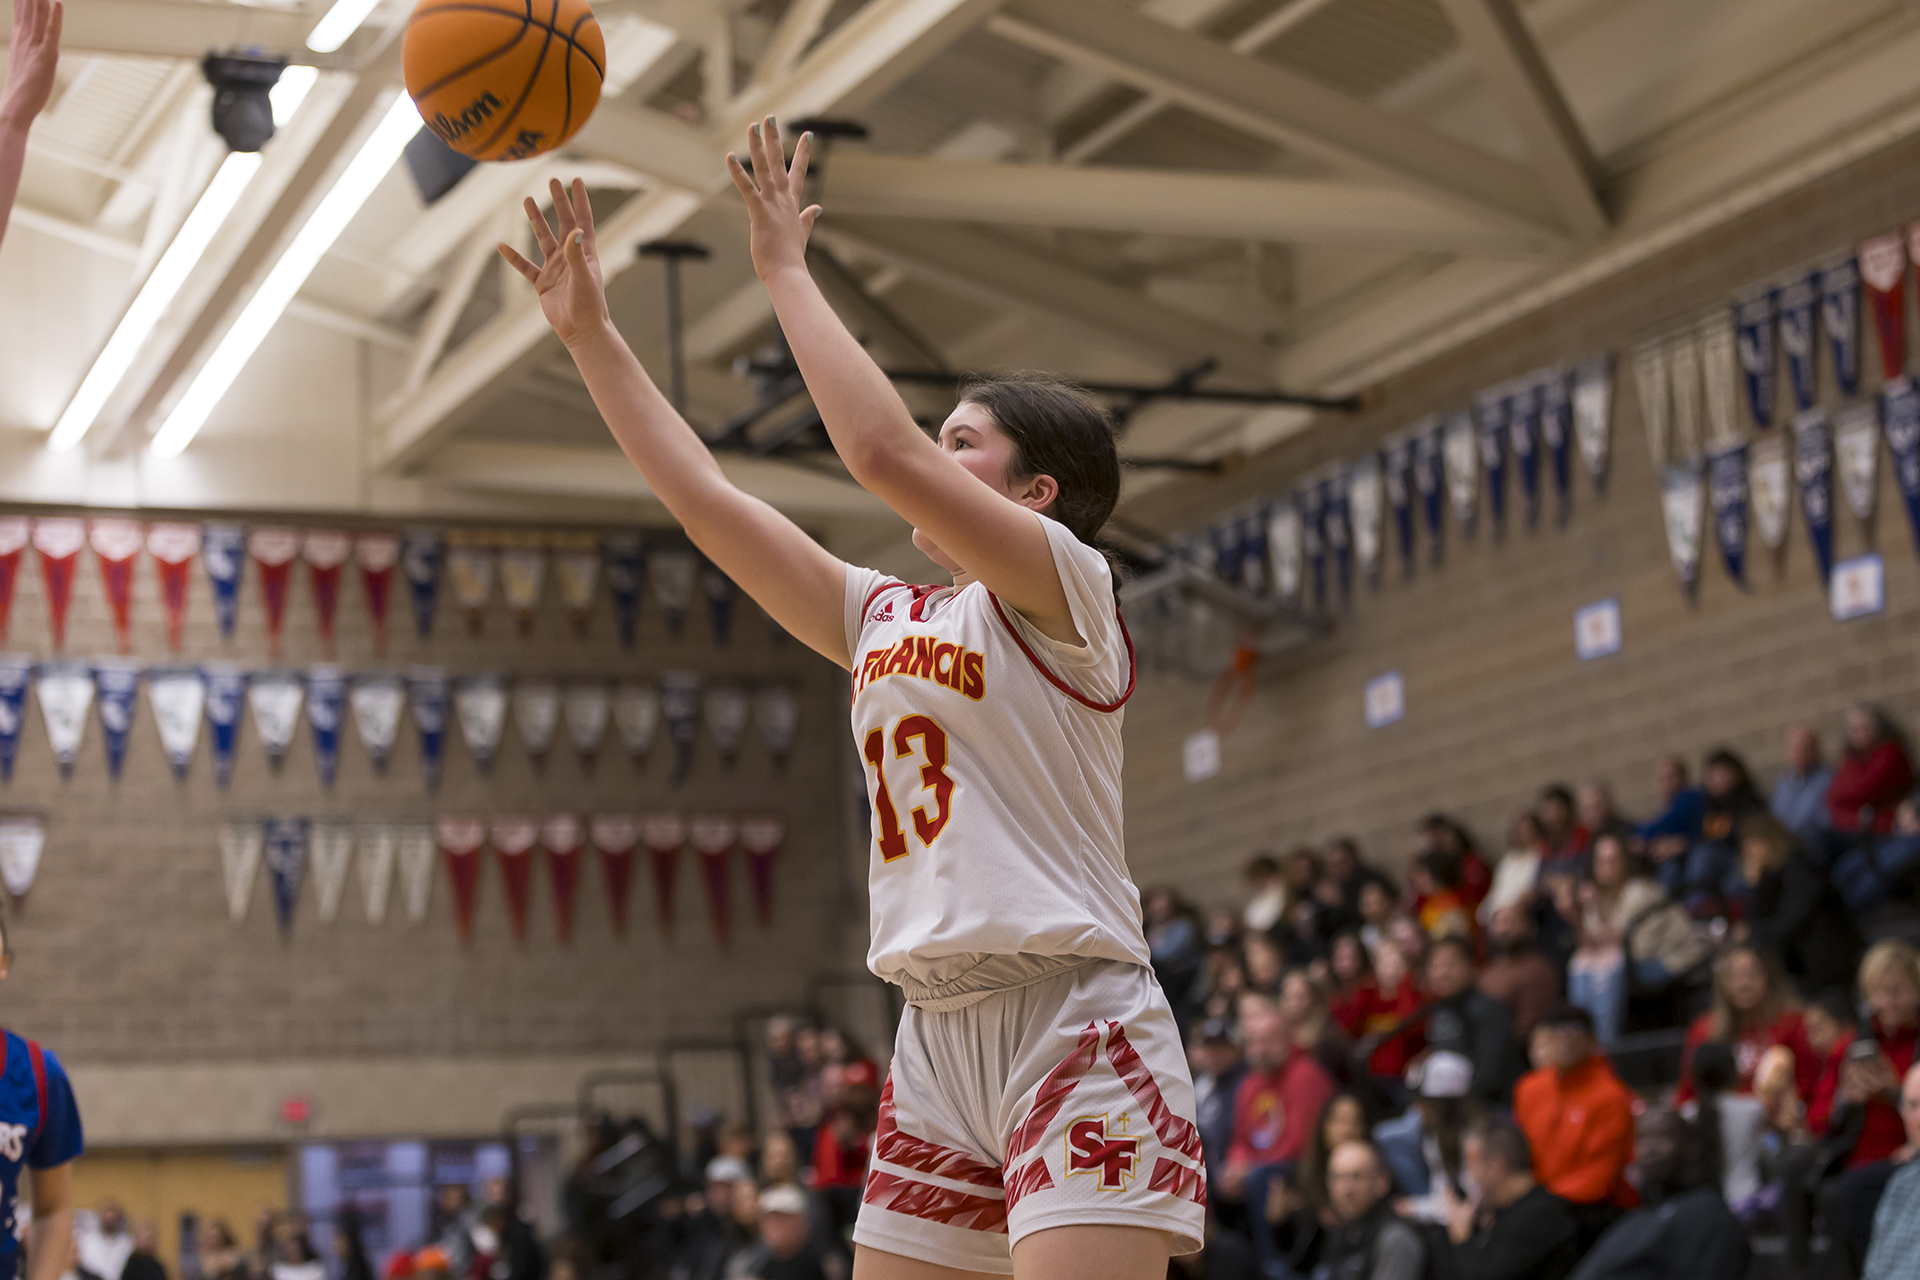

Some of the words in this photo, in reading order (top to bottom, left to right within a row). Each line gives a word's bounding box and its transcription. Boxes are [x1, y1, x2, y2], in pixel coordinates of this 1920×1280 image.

[858, 635, 986, 702] FRANCIS
[864, 713, 956, 864] 13
[1067, 1114, 1140, 1190] SF
